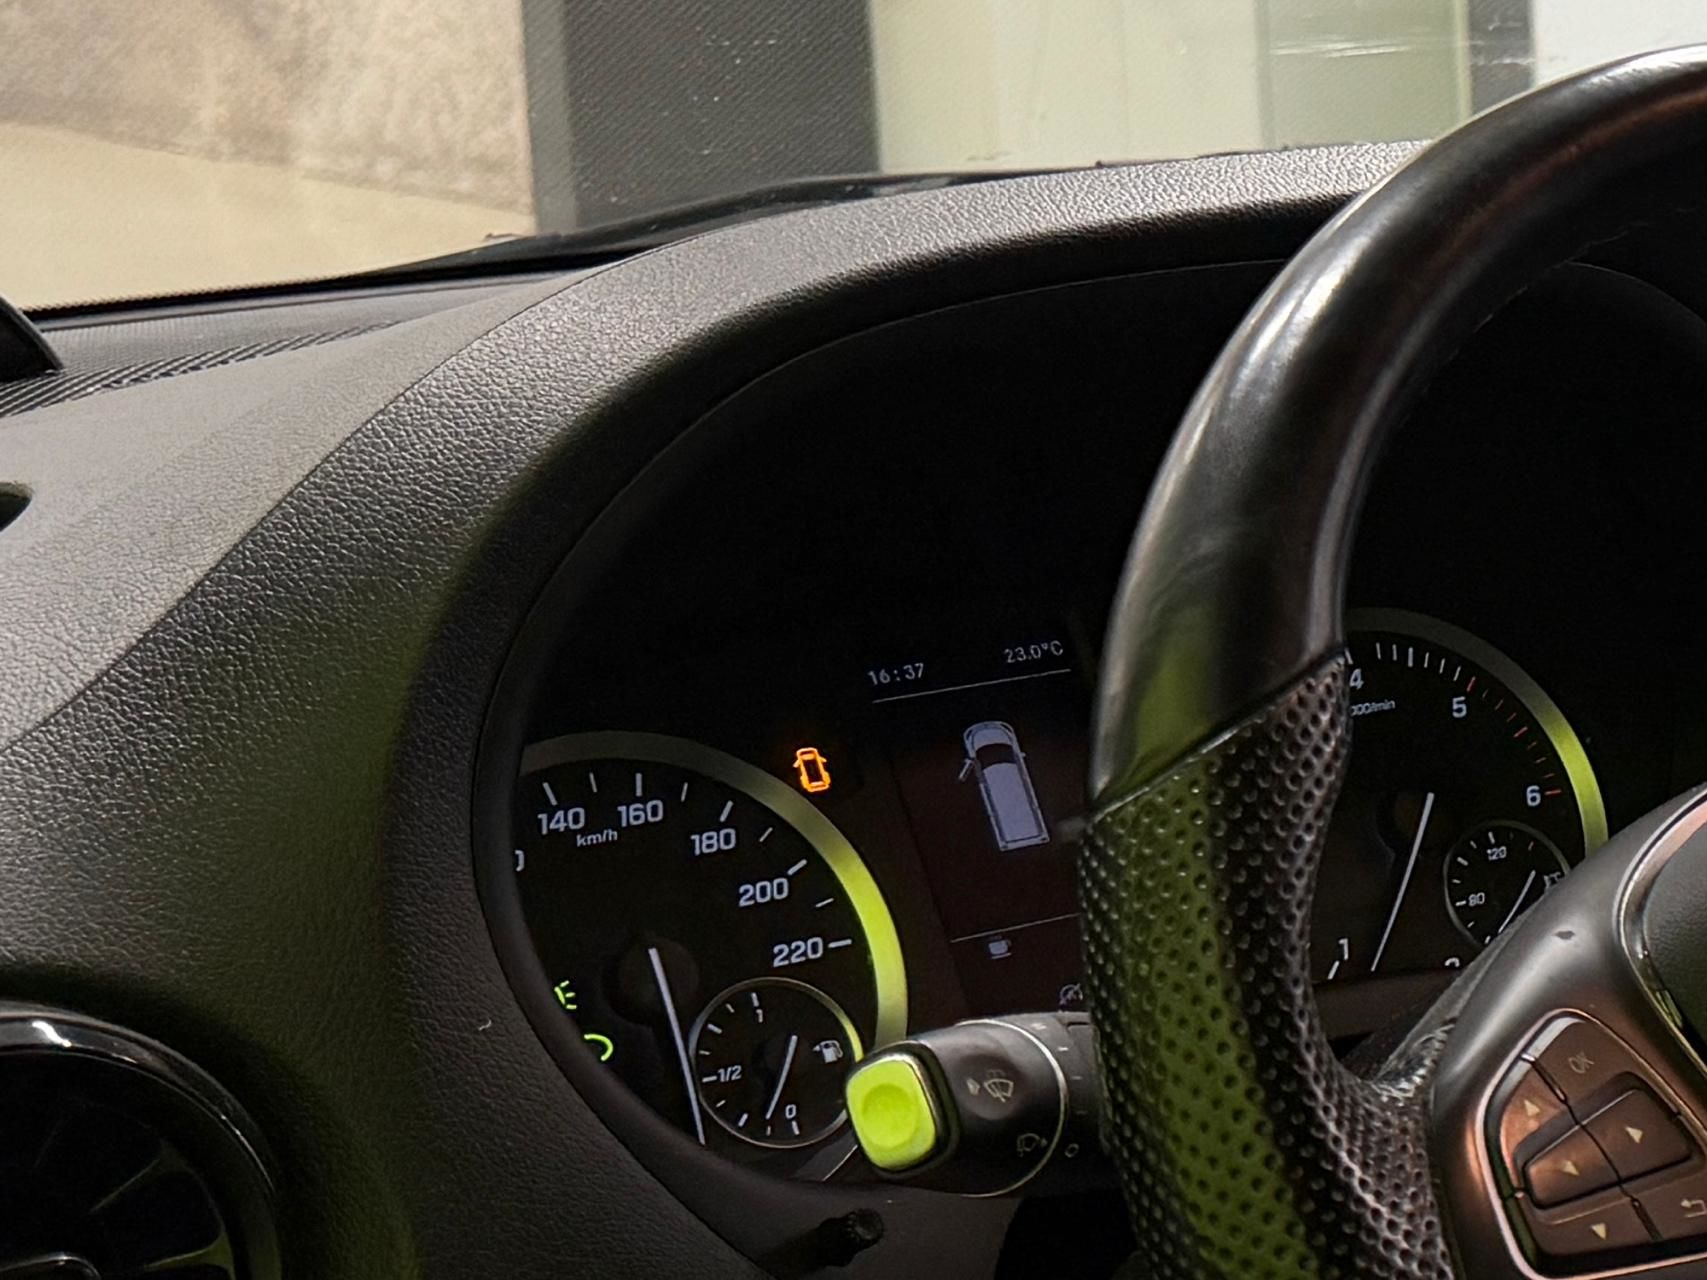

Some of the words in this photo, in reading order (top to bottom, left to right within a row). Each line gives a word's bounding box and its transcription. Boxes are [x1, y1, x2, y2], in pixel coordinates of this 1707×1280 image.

[868, 663, 925, 687] 16:37
[1004, 641, 1064, 665] 23.0°C
[1452, 697, 1467, 718] 5
[1526, 785, 1541, 807] 6
[537, 806, 586, 835] 140
[617, 800, 664, 827] 160
[576, 827, 618, 847] km/h
[691, 828, 737, 856] 180
[738, 877, 790, 907] 200
[1468, 892, 1486, 906] 80
[772, 936, 824, 968] 220
[1339, 938, 1349, 961] 1
[755, 1006, 765, 1023] 1
[718, 1065, 742, 1081] 1/2
[1570, 1052, 1595, 1074] OK
[784, 1104, 797, 1120] 0
